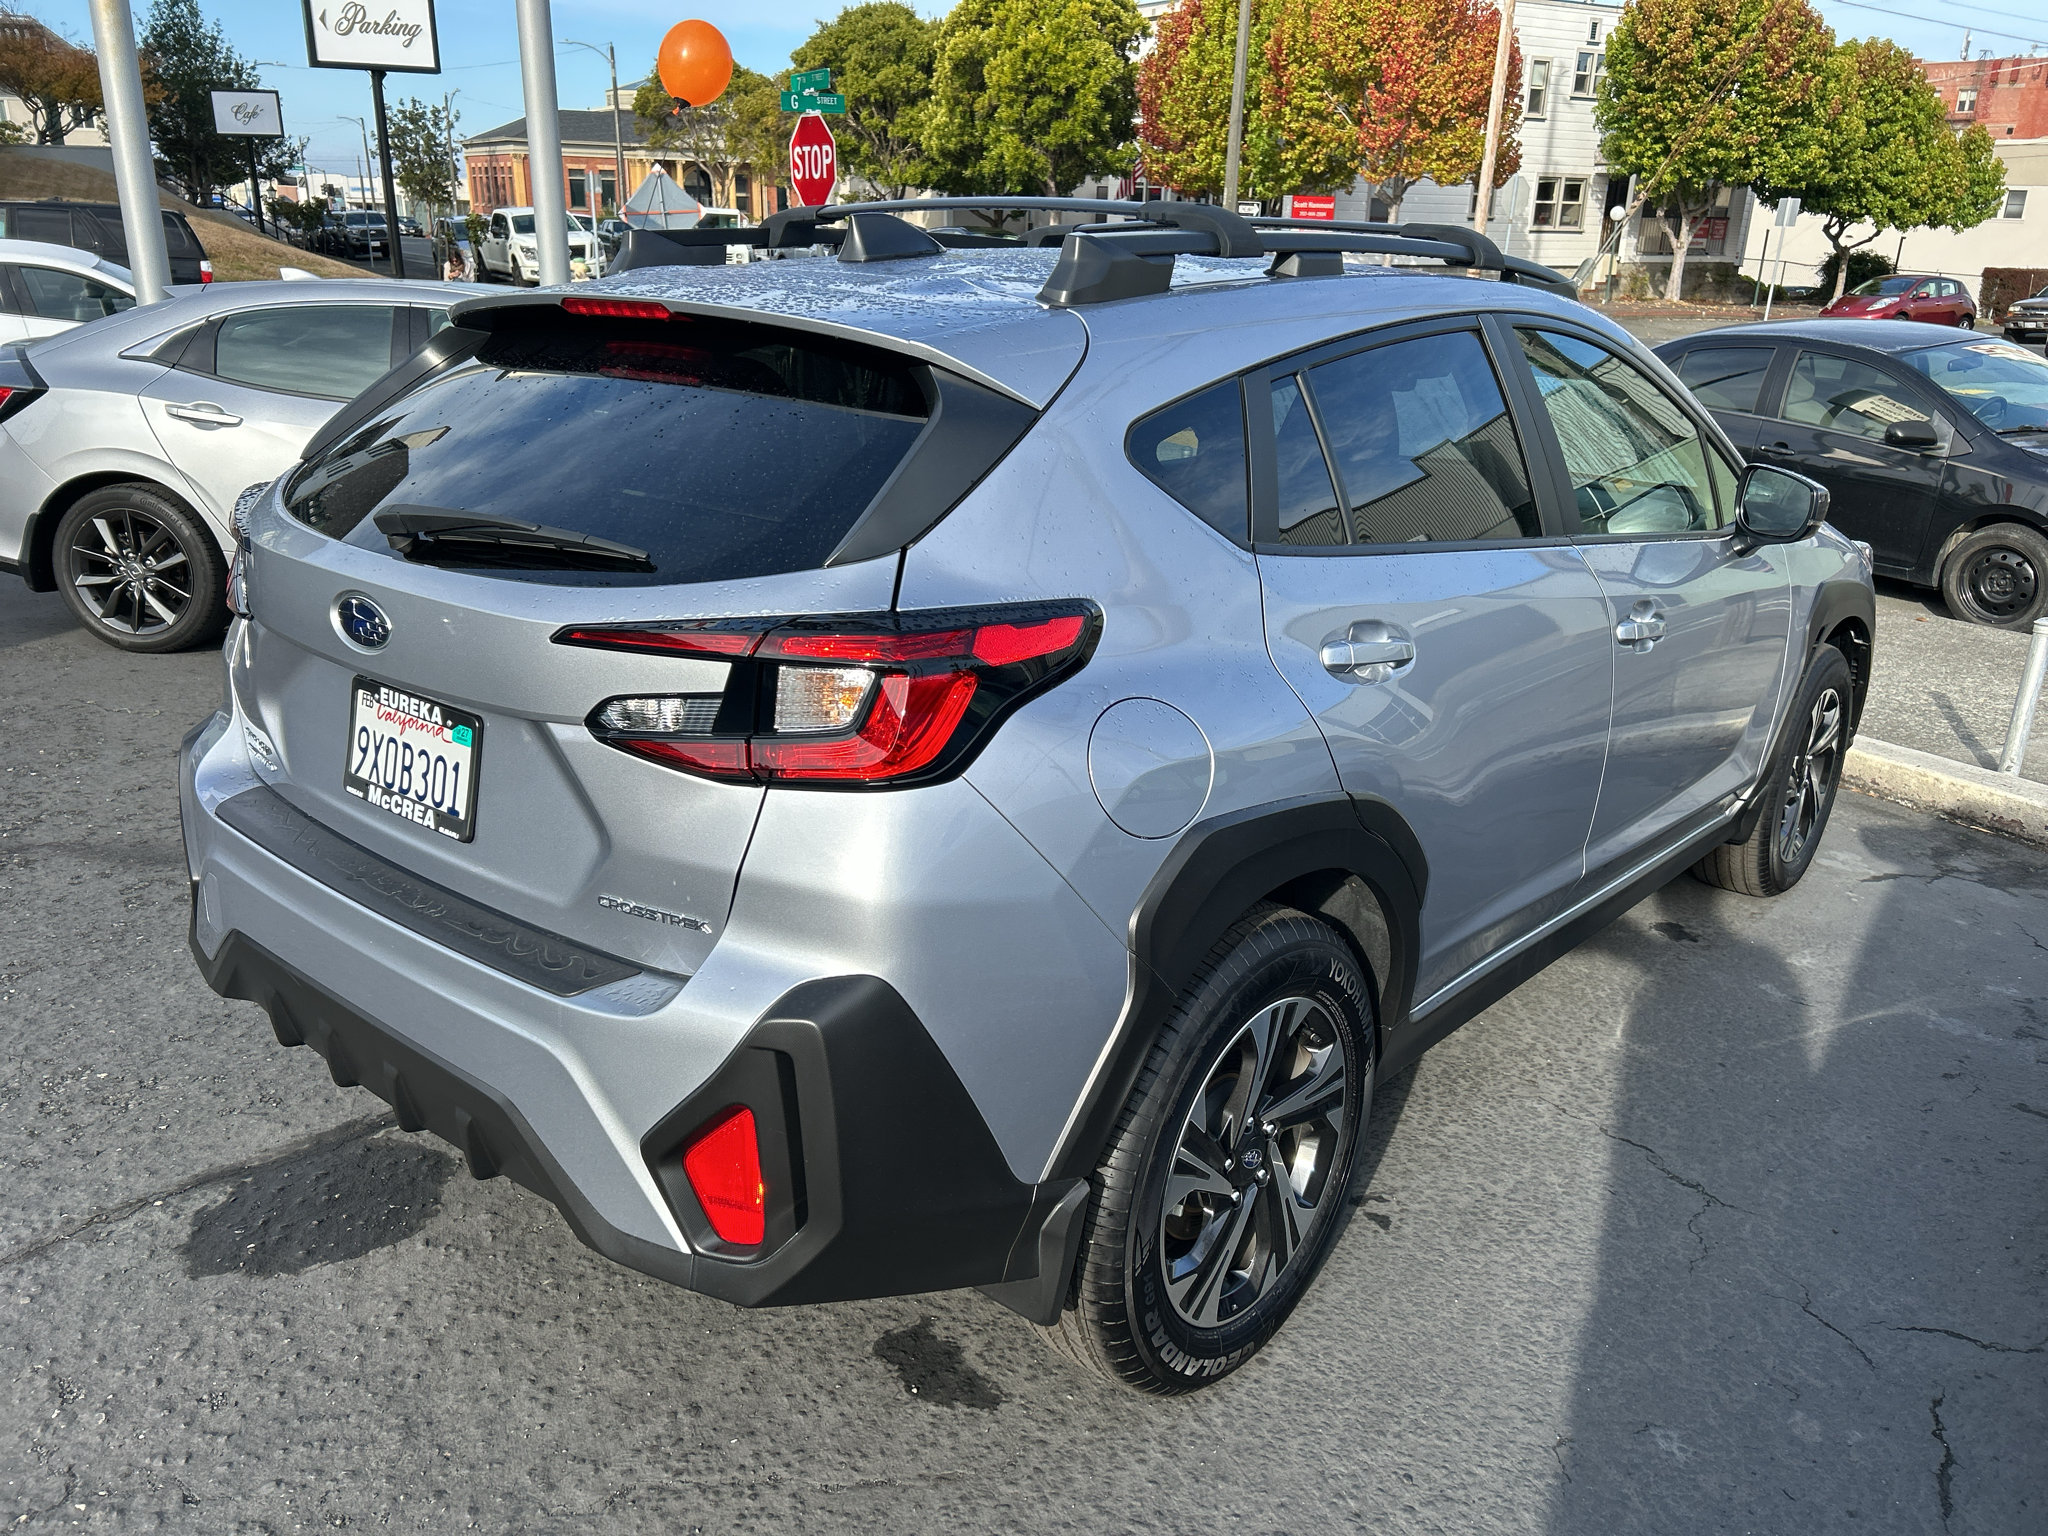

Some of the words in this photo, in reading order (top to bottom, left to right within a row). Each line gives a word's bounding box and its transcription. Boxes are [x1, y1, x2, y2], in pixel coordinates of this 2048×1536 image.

[334, 1, 423, 48] Parking
[230, 102, 264, 126] Café
[790, 94, 799, 109] G
[816, 96, 837, 105] STREET
[793, 144, 833, 180] STOP
[376, 703, 453, 744] California
[379, 686, 443, 726] EUREKA
[367, 784, 436, 830] McCREA
[598, 894, 713, 935] CROSSTREK
[1328, 957, 1374, 1044] YOKOHAMA
[1144, 1305, 1256, 1377] GEOLANDAR
